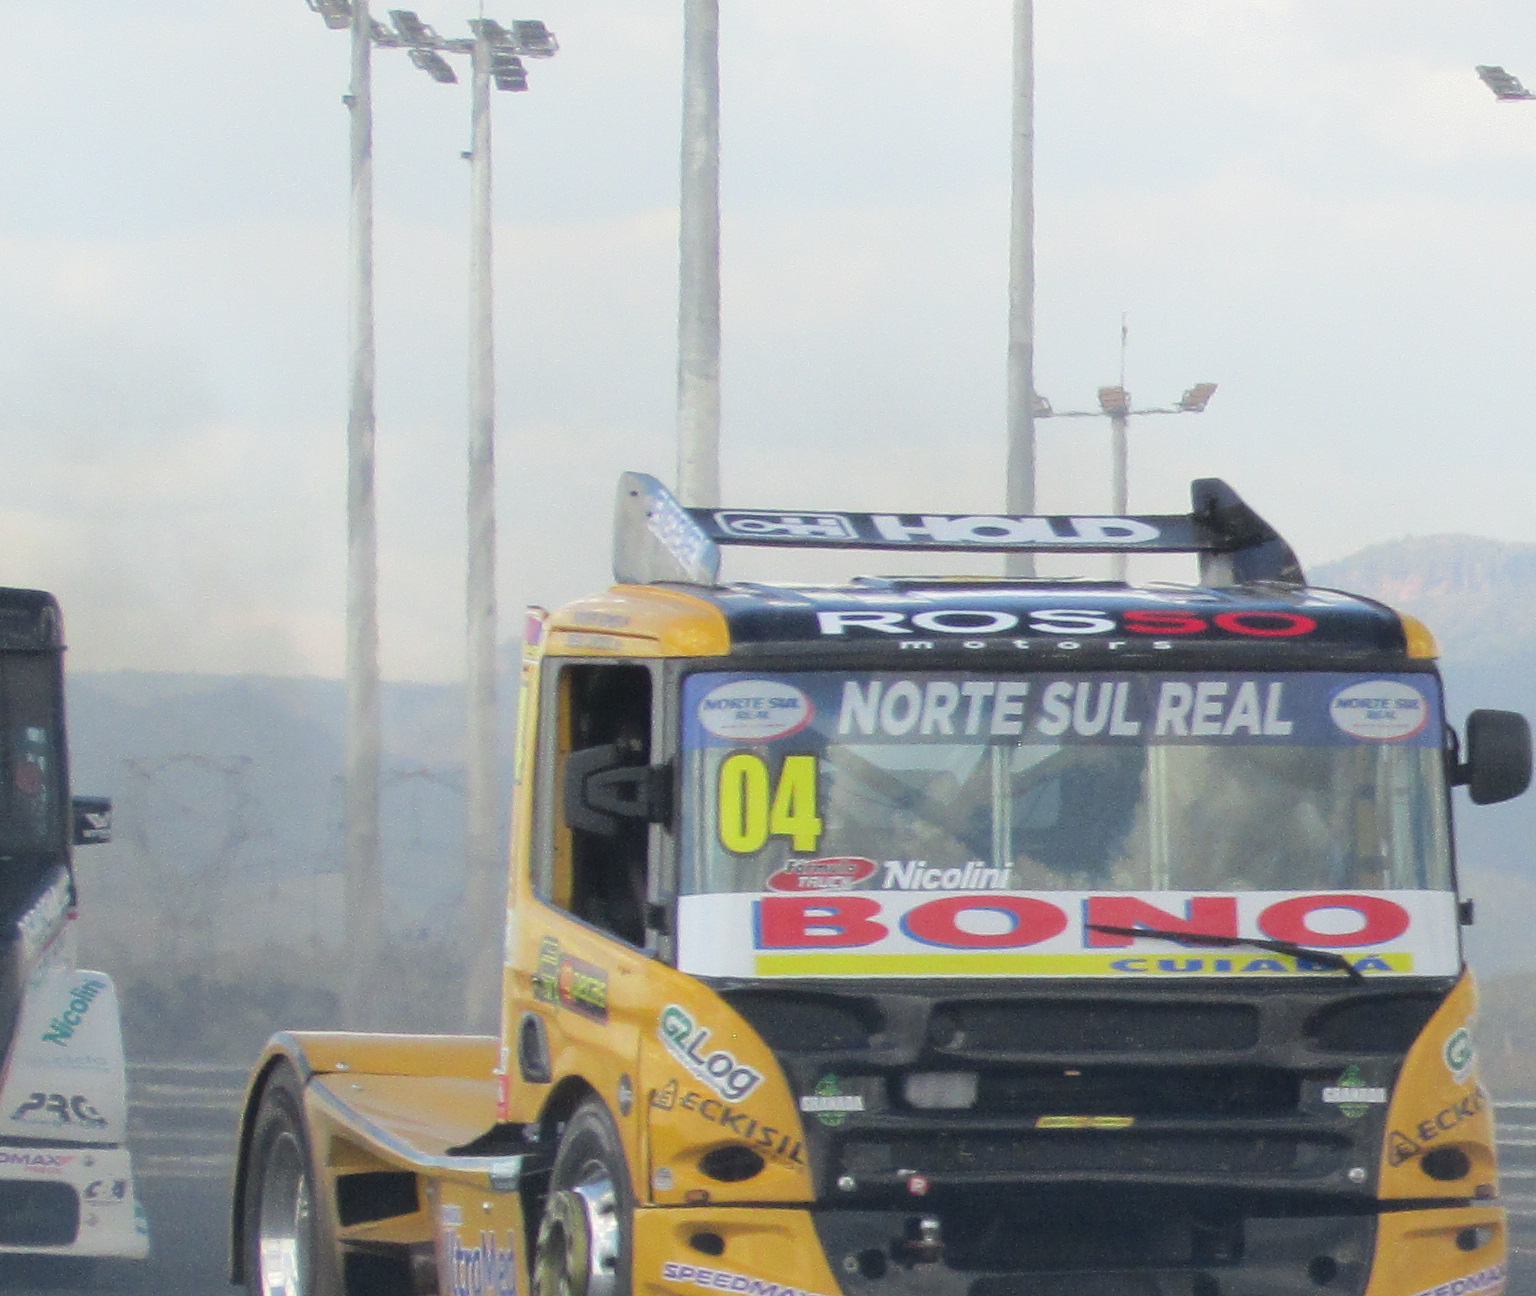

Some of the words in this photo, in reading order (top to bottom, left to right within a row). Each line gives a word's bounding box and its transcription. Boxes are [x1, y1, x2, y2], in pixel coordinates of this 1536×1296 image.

[870, 515, 1161, 543] HOLD
[817, 609, 1318, 638] ROSSO
[838, 680, 1029, 736] NORTE
[1036, 680, 1144, 737] SUL
[1153, 681, 1294, 737] REAL
[719, 754, 823, 854] 04
[882, 860, 1014, 890] Nicolini
[754, 895, 1411, 950] BONO
